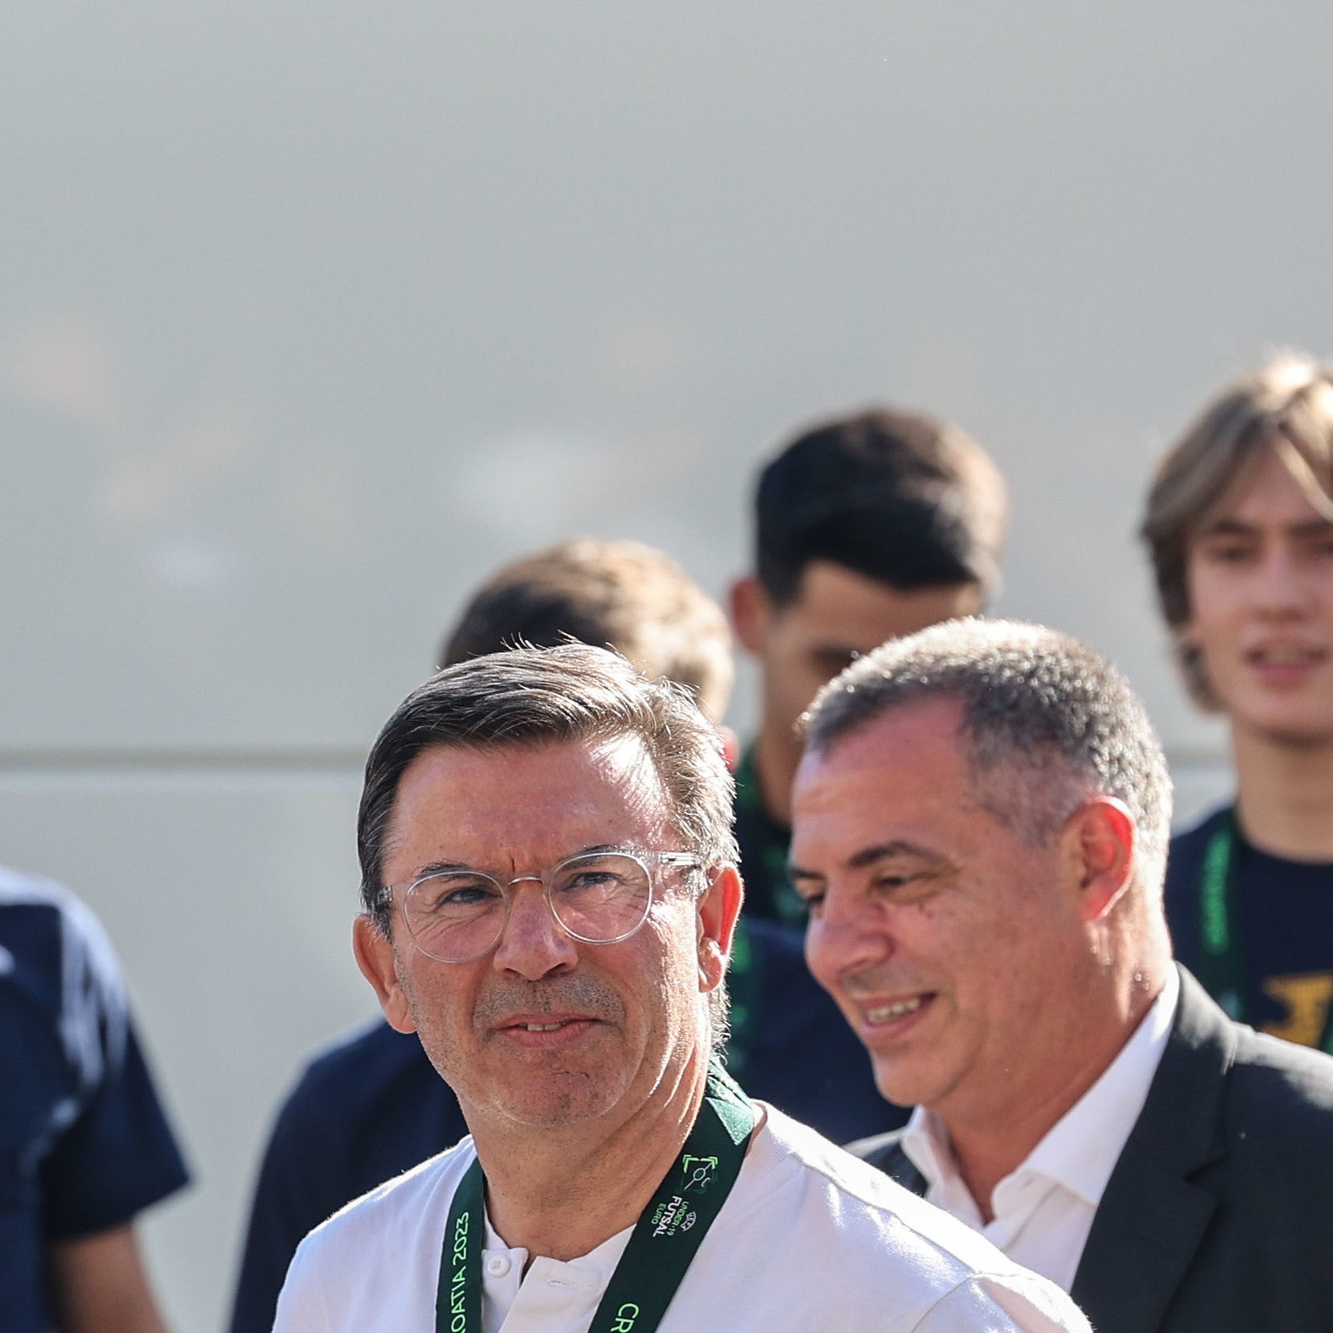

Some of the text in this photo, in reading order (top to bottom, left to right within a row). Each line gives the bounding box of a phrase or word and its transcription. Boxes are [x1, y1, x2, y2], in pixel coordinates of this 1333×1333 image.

[651, 1203, 667, 1225] EURO
[652, 1195, 683, 1237] FUTSAL
[666, 1201, 690, 1236] UNDER-19
[453, 1211, 470, 1266] 2023
